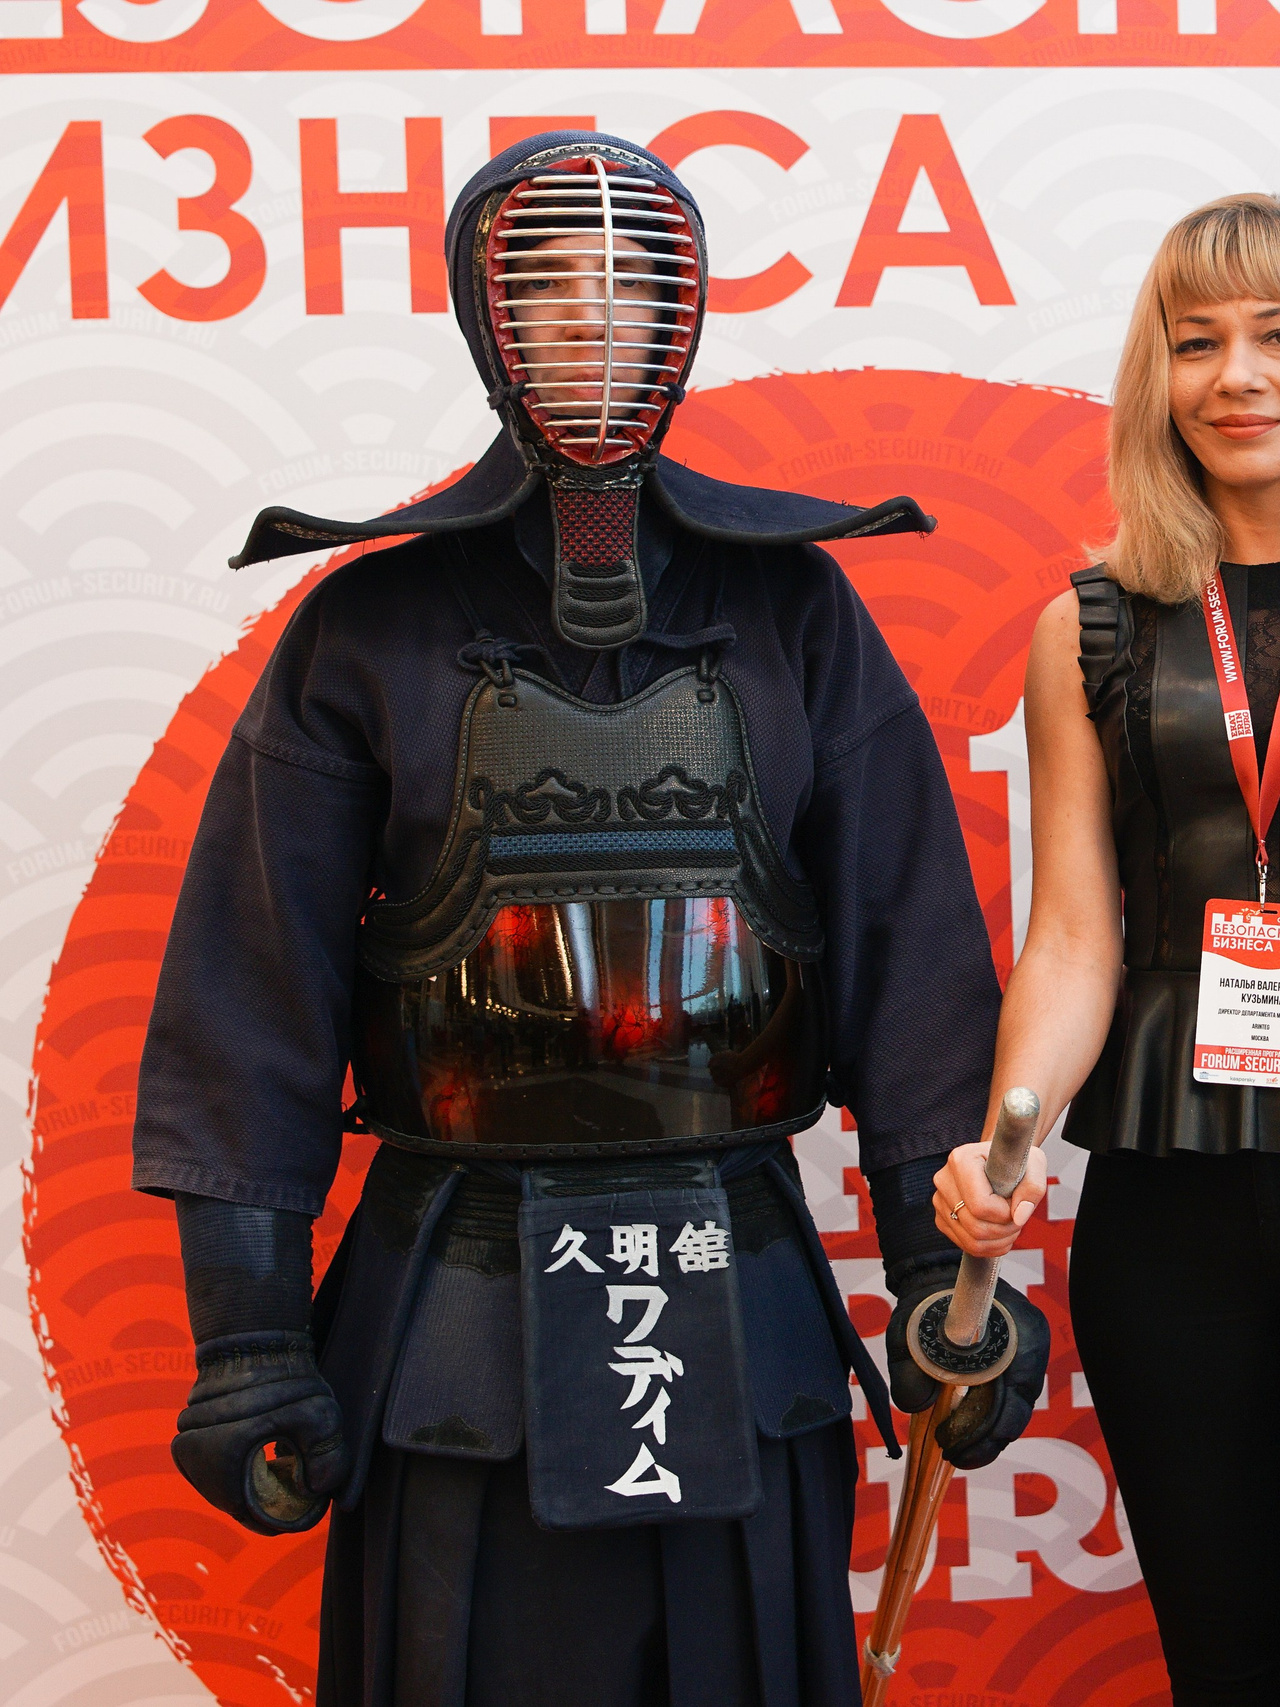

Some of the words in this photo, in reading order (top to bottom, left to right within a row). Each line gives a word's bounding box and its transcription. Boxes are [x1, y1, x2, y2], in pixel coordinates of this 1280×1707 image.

[1206, 574, 1238, 683] WWW.FORUM-SECU
[1235, 712, 1245, 736] ERIN
[1212, 936, 1274, 953] БИЗНЕСА
[1219, 978, 1256, 990] НАТАЛЬЯ
